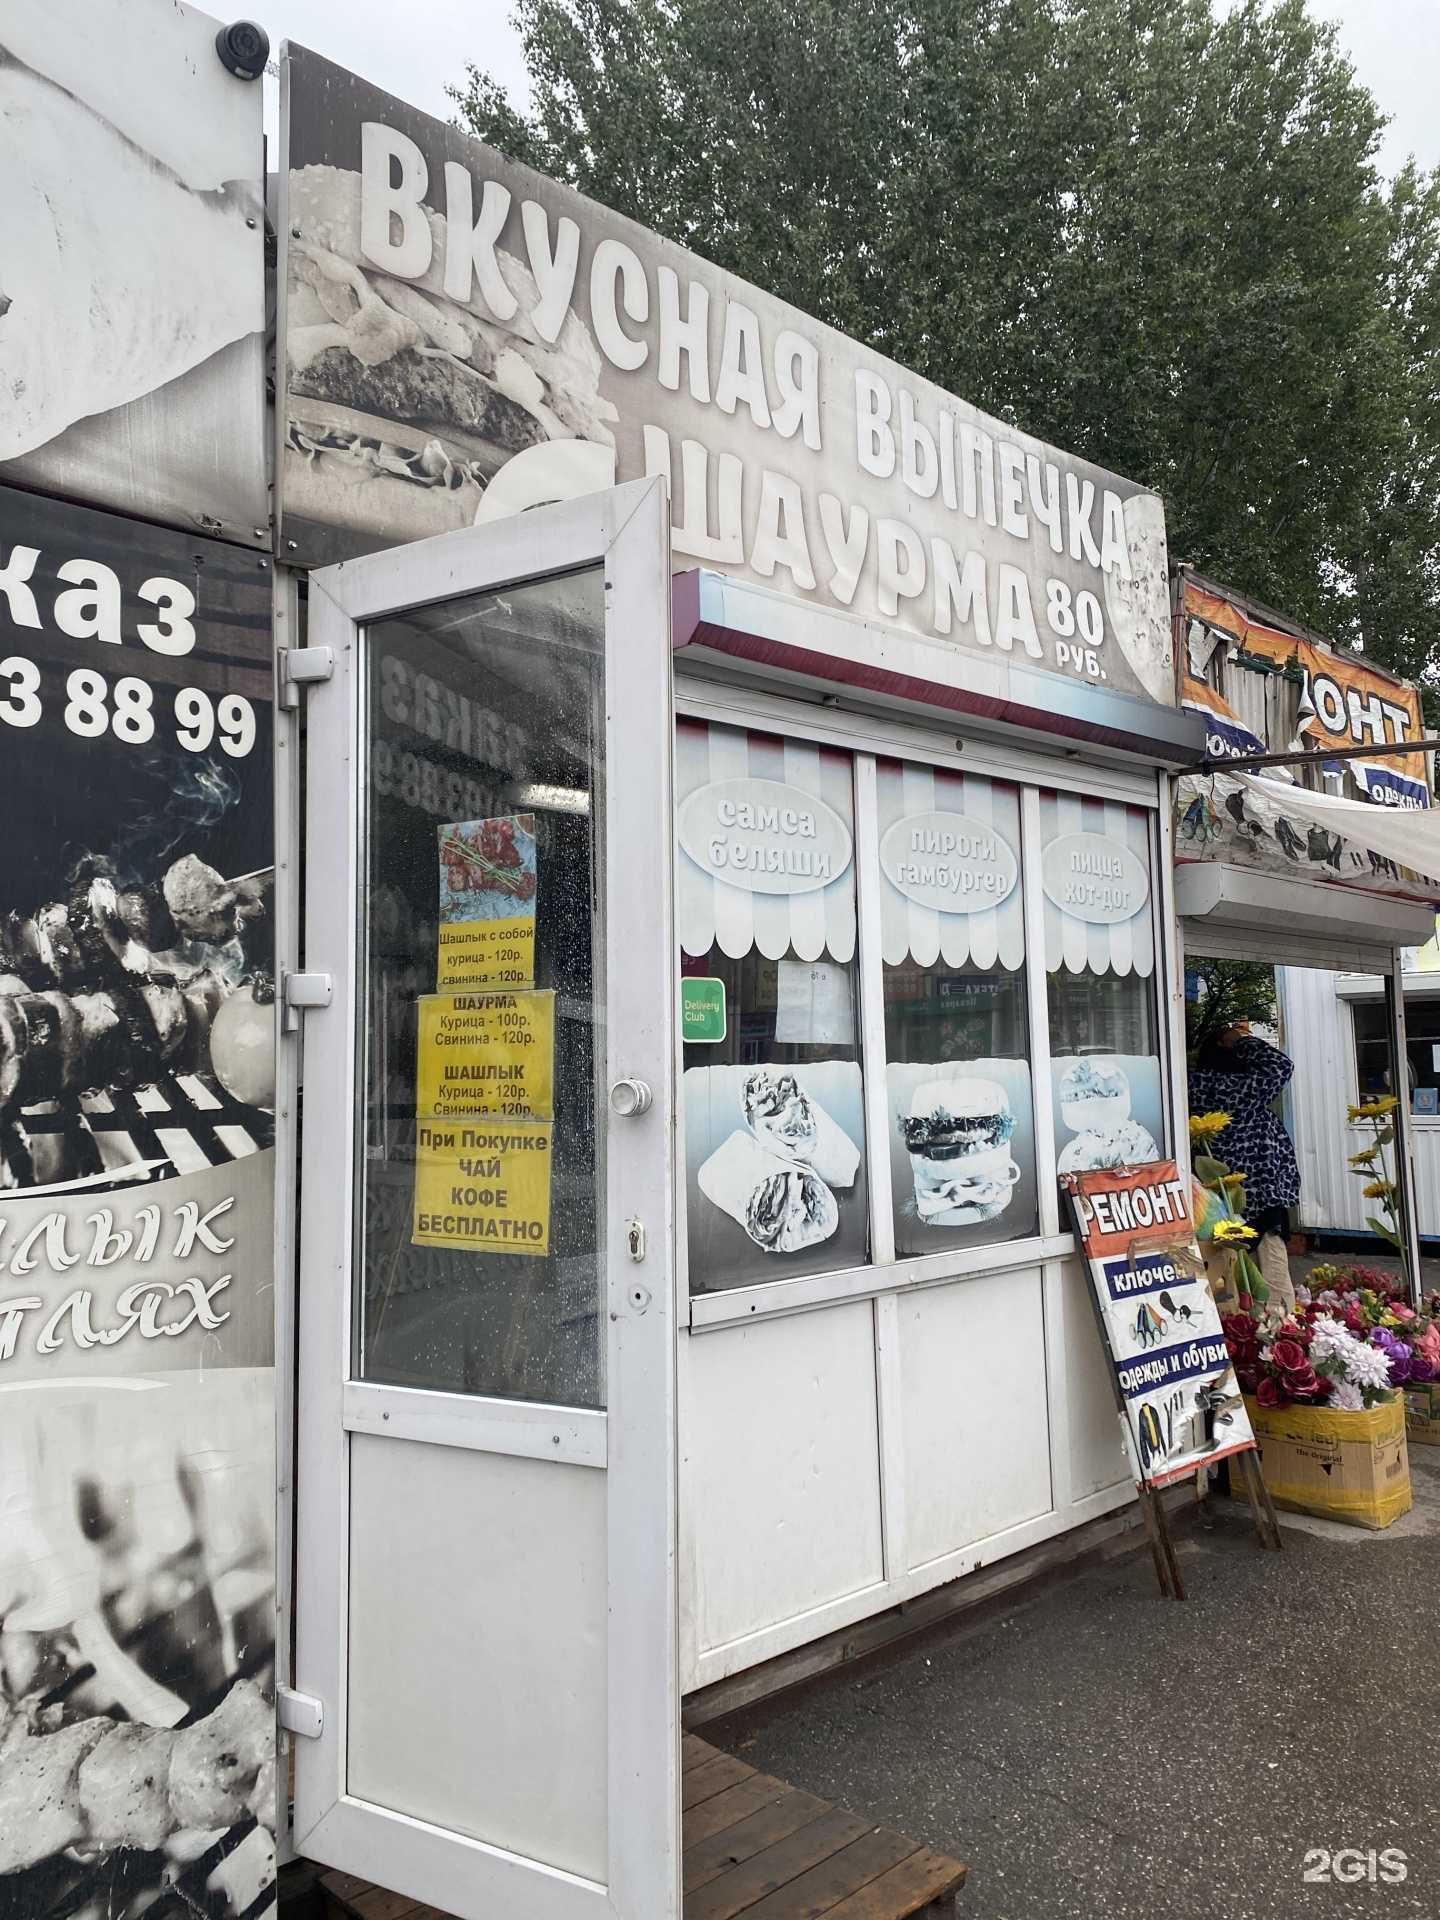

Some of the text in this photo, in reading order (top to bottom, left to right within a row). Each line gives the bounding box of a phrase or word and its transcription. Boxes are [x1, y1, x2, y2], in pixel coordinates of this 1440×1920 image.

[360, 121, 1132, 581] ВКУСНАЯ ВЫПЕЧКА
[643, 424, 1044, 659] ШАУРМА
[1045, 578, 1105, 647] 80
[64, 668, 155, 744] 88
[174, 687, 256, 758] 99
[718, 799, 816, 838] самса
[708, 832, 832, 878] беляши
[1071, 851, 1124, 879] пицца
[896, 862, 1009, 897] гамбургер
[1064, 883, 1131, 911] хот-дог
[439, 927, 534, 945] Шашлык с собой
[447, 952, 485, 967] курица
[495, 950, 523, 963] 120р.
[442, 975, 488, 985] свинина
[499, 970, 527, 983] 120р.
[453, 996, 517, 1011] ШАУРМА
[684, 1000, 720, 1013] Delivery
[440, 1015, 485, 1031] Курица
[497, 1013, 530, 1028] 100р.
[684, 1010, 706, 1022] Club
[435, 1033, 490, 1046] Свинина
[502, 1031, 536, 1046] 120р.
[444, 1065, 525, 1080] ШАШЛЫК
[439, 1085, 484, 1099] Курица
[497, 1085, 530, 1099] 120р.
[433, 1102, 489, 1115] Свинина
[419, 1129, 548, 1153] При Покупке
[459, 1156, 501, 1178] ЧАЙ
[451, 1187, 508, 1208] КОФЕ
[1072, 1181, 1187, 1237] РЕМОНТ
[0, 1197, 235, 1275] ЛЫК
[418, 1213, 544, 1241] БЕСПЛАТНО
[1118, 1342, 1230, 1390] одежды и обуви
